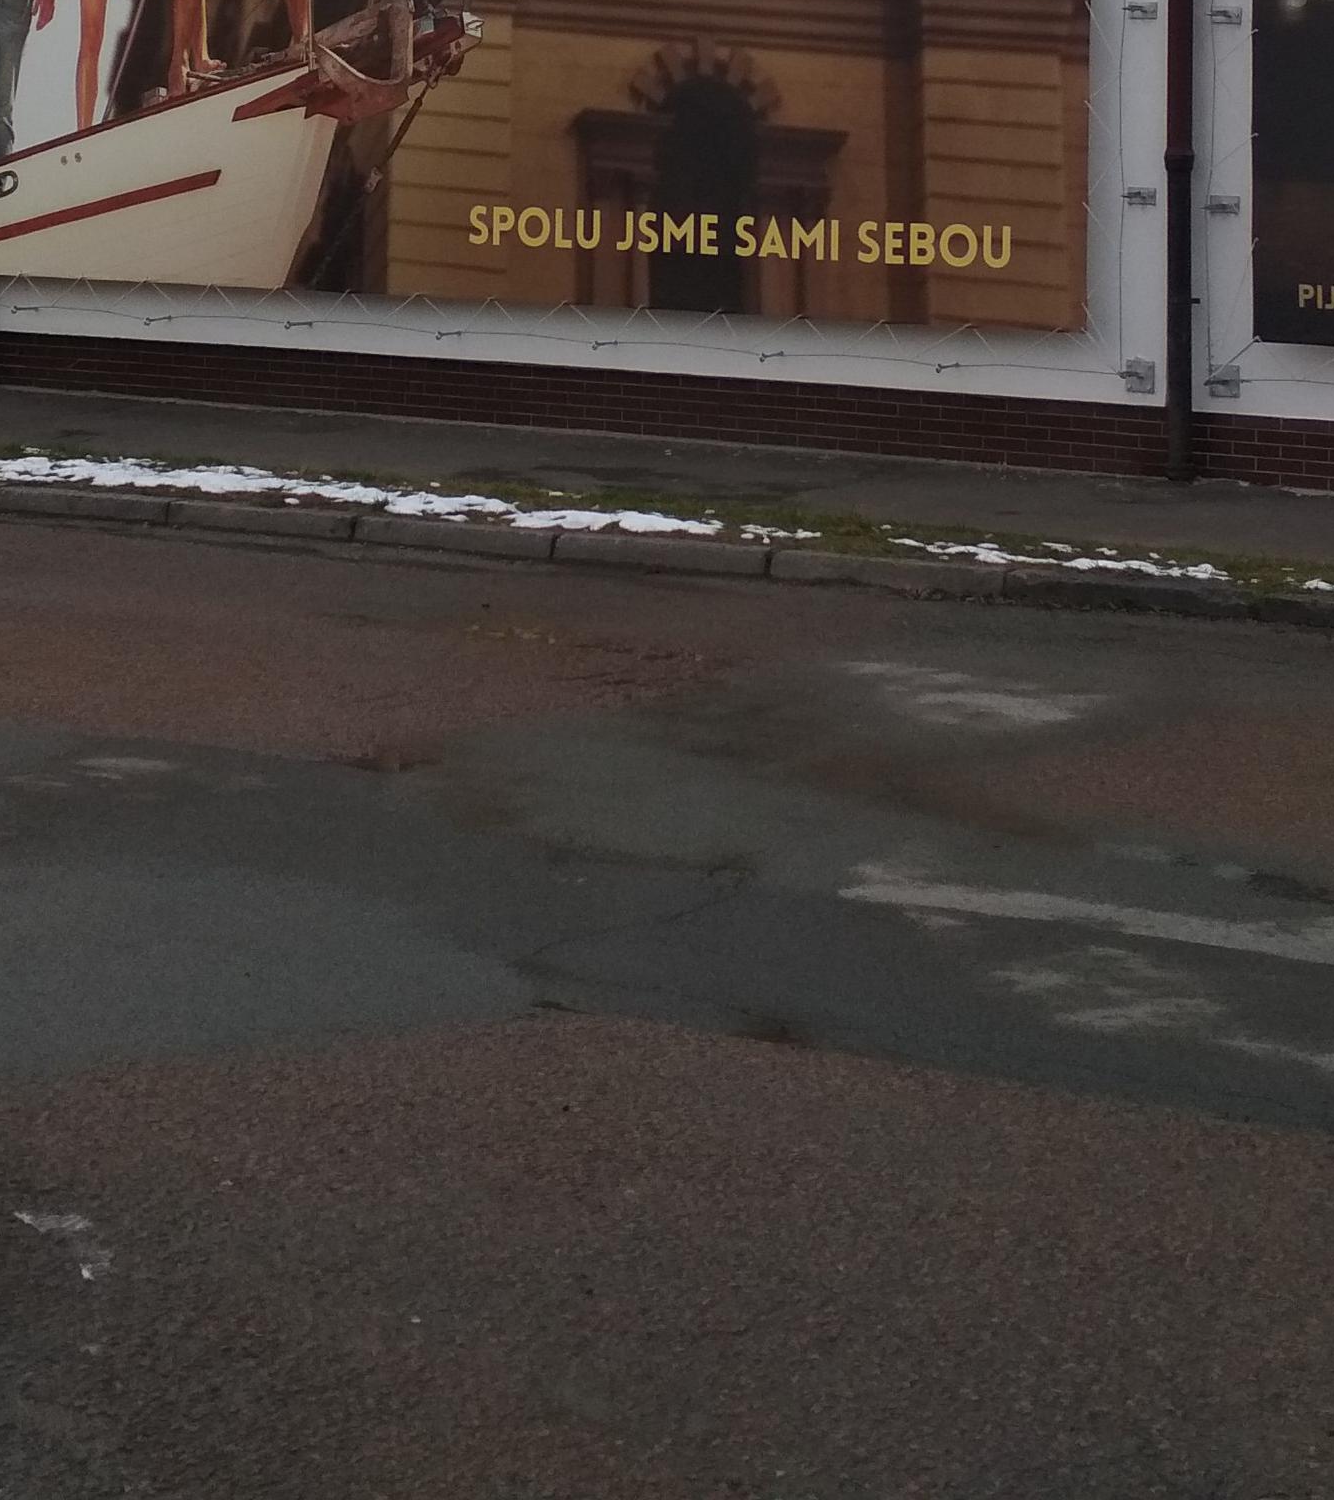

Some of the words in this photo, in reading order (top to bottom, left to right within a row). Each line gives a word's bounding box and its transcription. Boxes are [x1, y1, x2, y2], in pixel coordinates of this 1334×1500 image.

[468, 205, 602, 250] SPOLU
[615, 211, 719, 256] JSME
[734, 215, 840, 261] SAMI
[856, 221, 1012, 269] SEBOU
